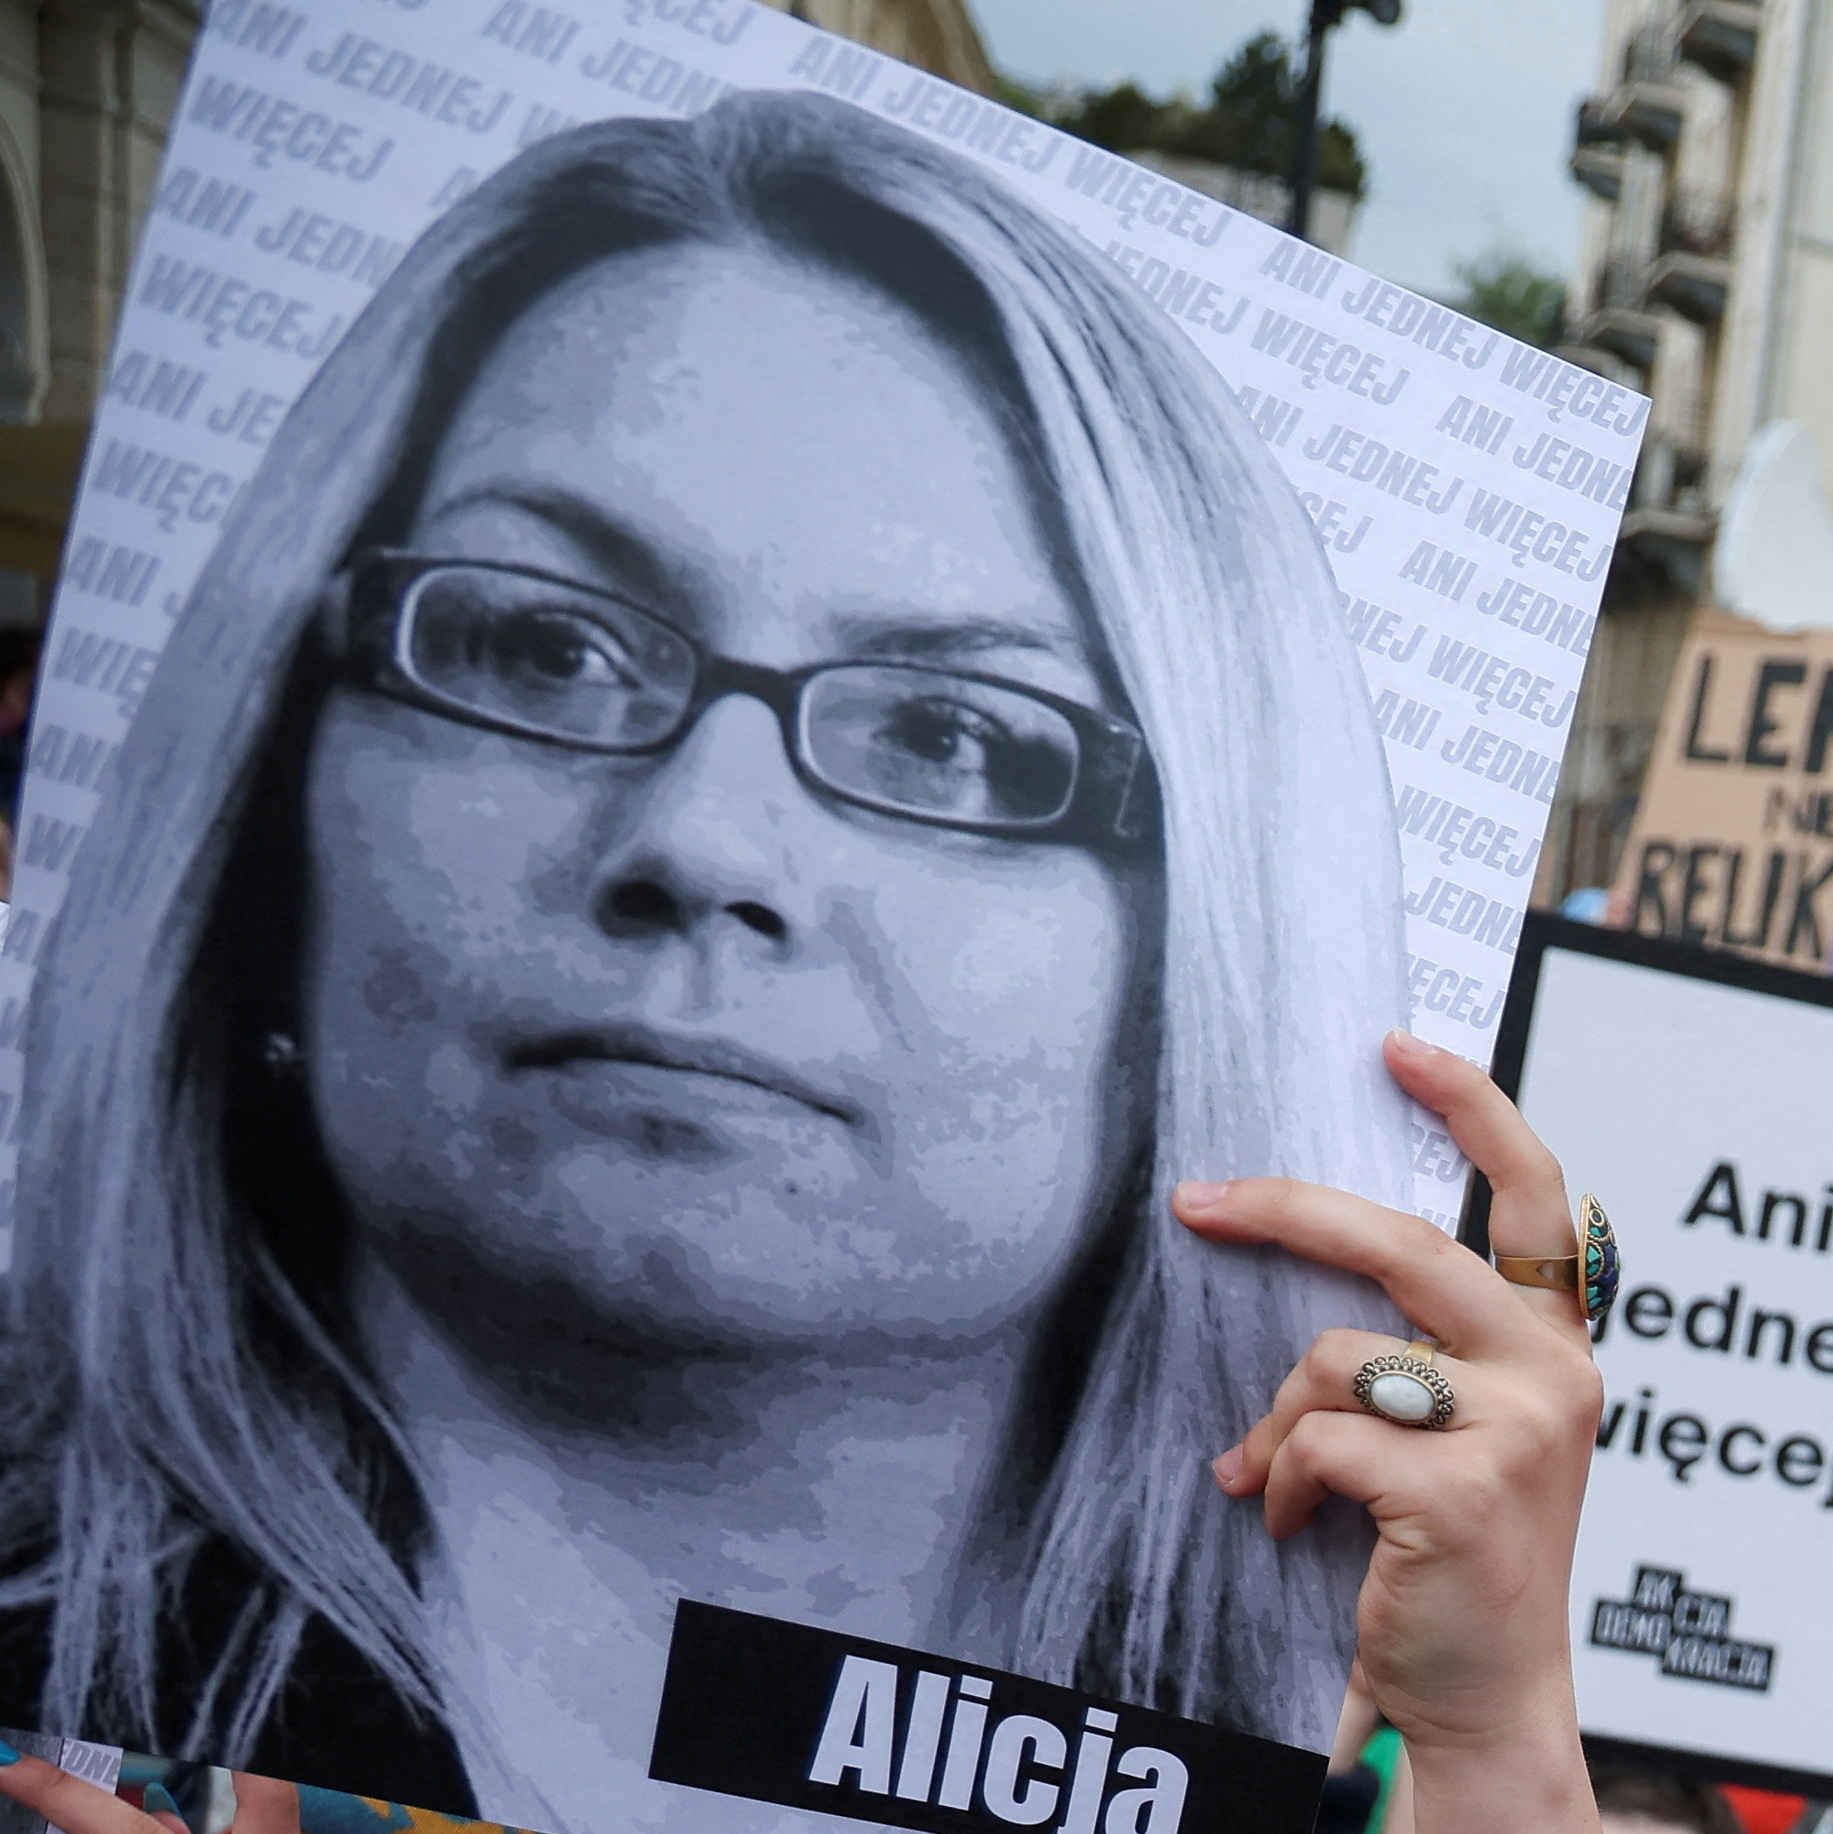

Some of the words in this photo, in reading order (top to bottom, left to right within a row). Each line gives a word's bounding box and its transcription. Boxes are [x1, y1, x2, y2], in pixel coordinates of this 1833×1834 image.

[140, 253, 345, 360] WIĘCEJ
[155, 168, 256, 239] ANI
[1426, 634, 1577, 729] WIĘCEJ
[189, 74, 396, 182] WIĘCEJ
[1398, 540, 1478, 602] ANI
[206, 0, 308, 61] ANI
[306, 32, 514, 133] JEDNEJ
[1302, 423, 1464, 515] JEDNEJ
[1463, 487, 1613, 583] WIĘCEJ
[480, 0, 582, 64] ANI
[1250, 307, 1411, 406] WIĘCEJ
[1435, 394, 1515, 456] ANI
[789, 36, 884, 99] ANI
[884, 76, 1066, 174] JEDNEJ
[1064, 146, 1234, 248] WIĘCEJ
[1259, 239, 1344, 300] ANI
[1341, 278, 1501, 370] JEDNEJ
[1500, 342, 1650, 437] WIĘCEJ
[67, 534, 163, 608] ANI
[108, 350, 208, 423] ANI
[1399, 784, 1541, 878] WIĘCEJ
